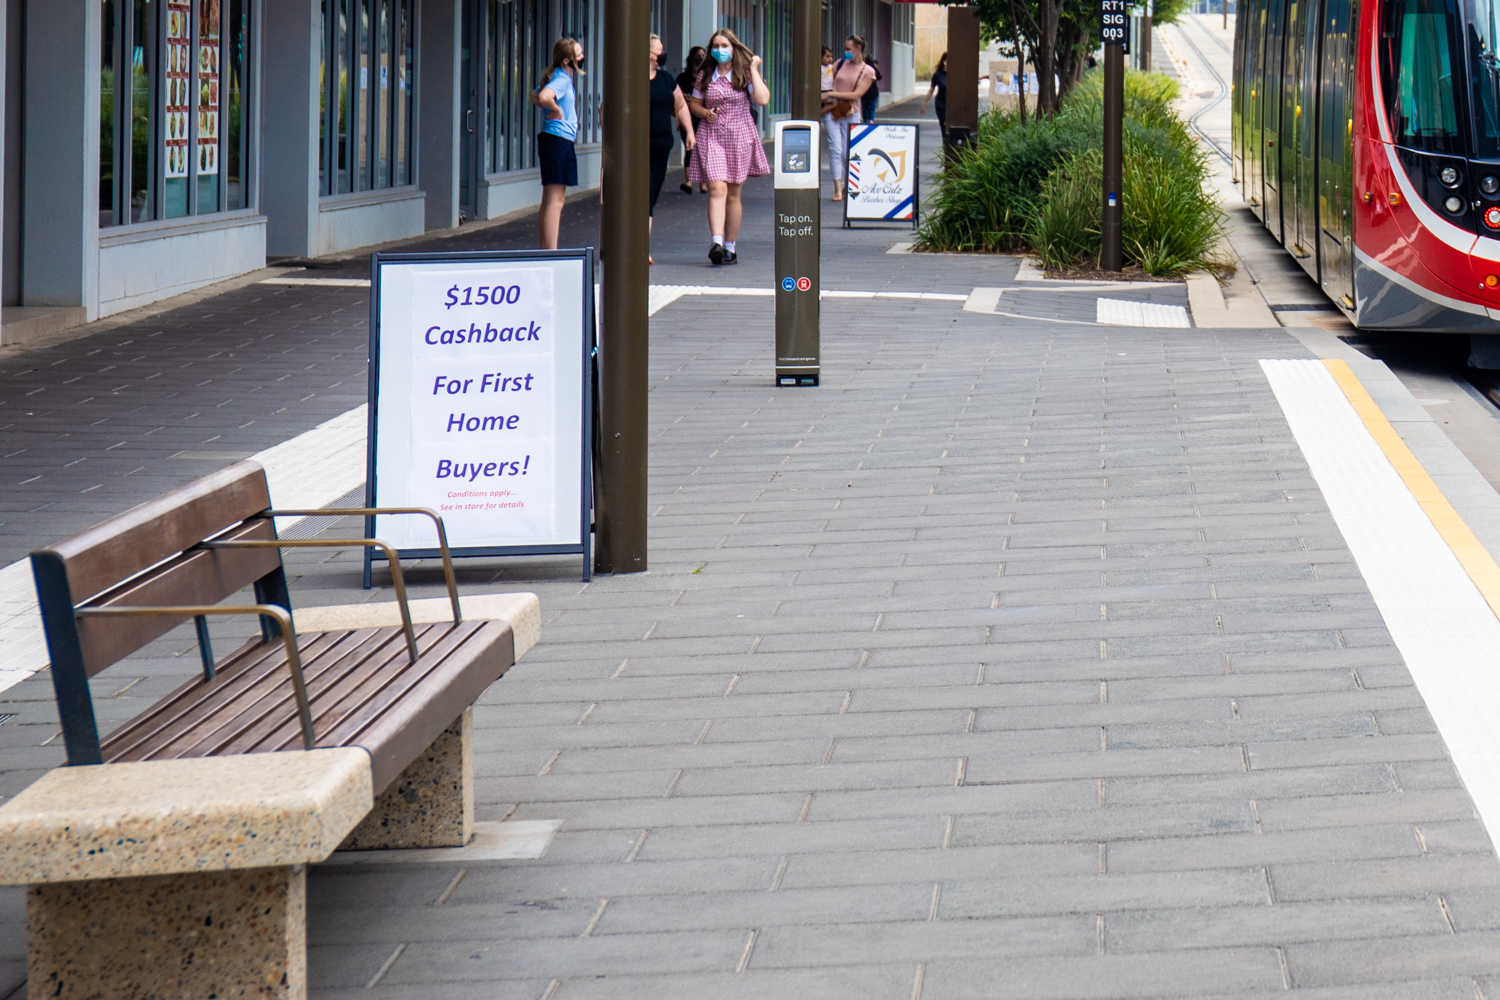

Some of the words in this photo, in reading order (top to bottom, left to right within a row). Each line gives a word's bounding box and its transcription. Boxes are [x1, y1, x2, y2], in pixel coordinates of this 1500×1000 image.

[1102, 1, 1124, 11] RT1
[1102, 14, 1124, 24] SIG
[1102, 28, 1124, 38] 003
[779, 213, 797, 225] Tap
[797, 215, 813, 223] on.
[779, 226, 797, 238] Tap
[797, 225, 814, 236] off.
[444, 284, 521, 309] $1500
[424, 320, 542, 345] Cashback
[432, 375, 473, 395] For
[480, 372, 534, 394] First
[446, 412, 520, 433] Home
[435, 455, 531, 482] Buyers!
[447, 489, 488, 499] Conditions
[439, 503, 453, 511] See
[453, 502, 462, 511] in
[463, 502, 484, 511] store
[485, 501, 497, 511] for
[498, 500, 525, 510] details
